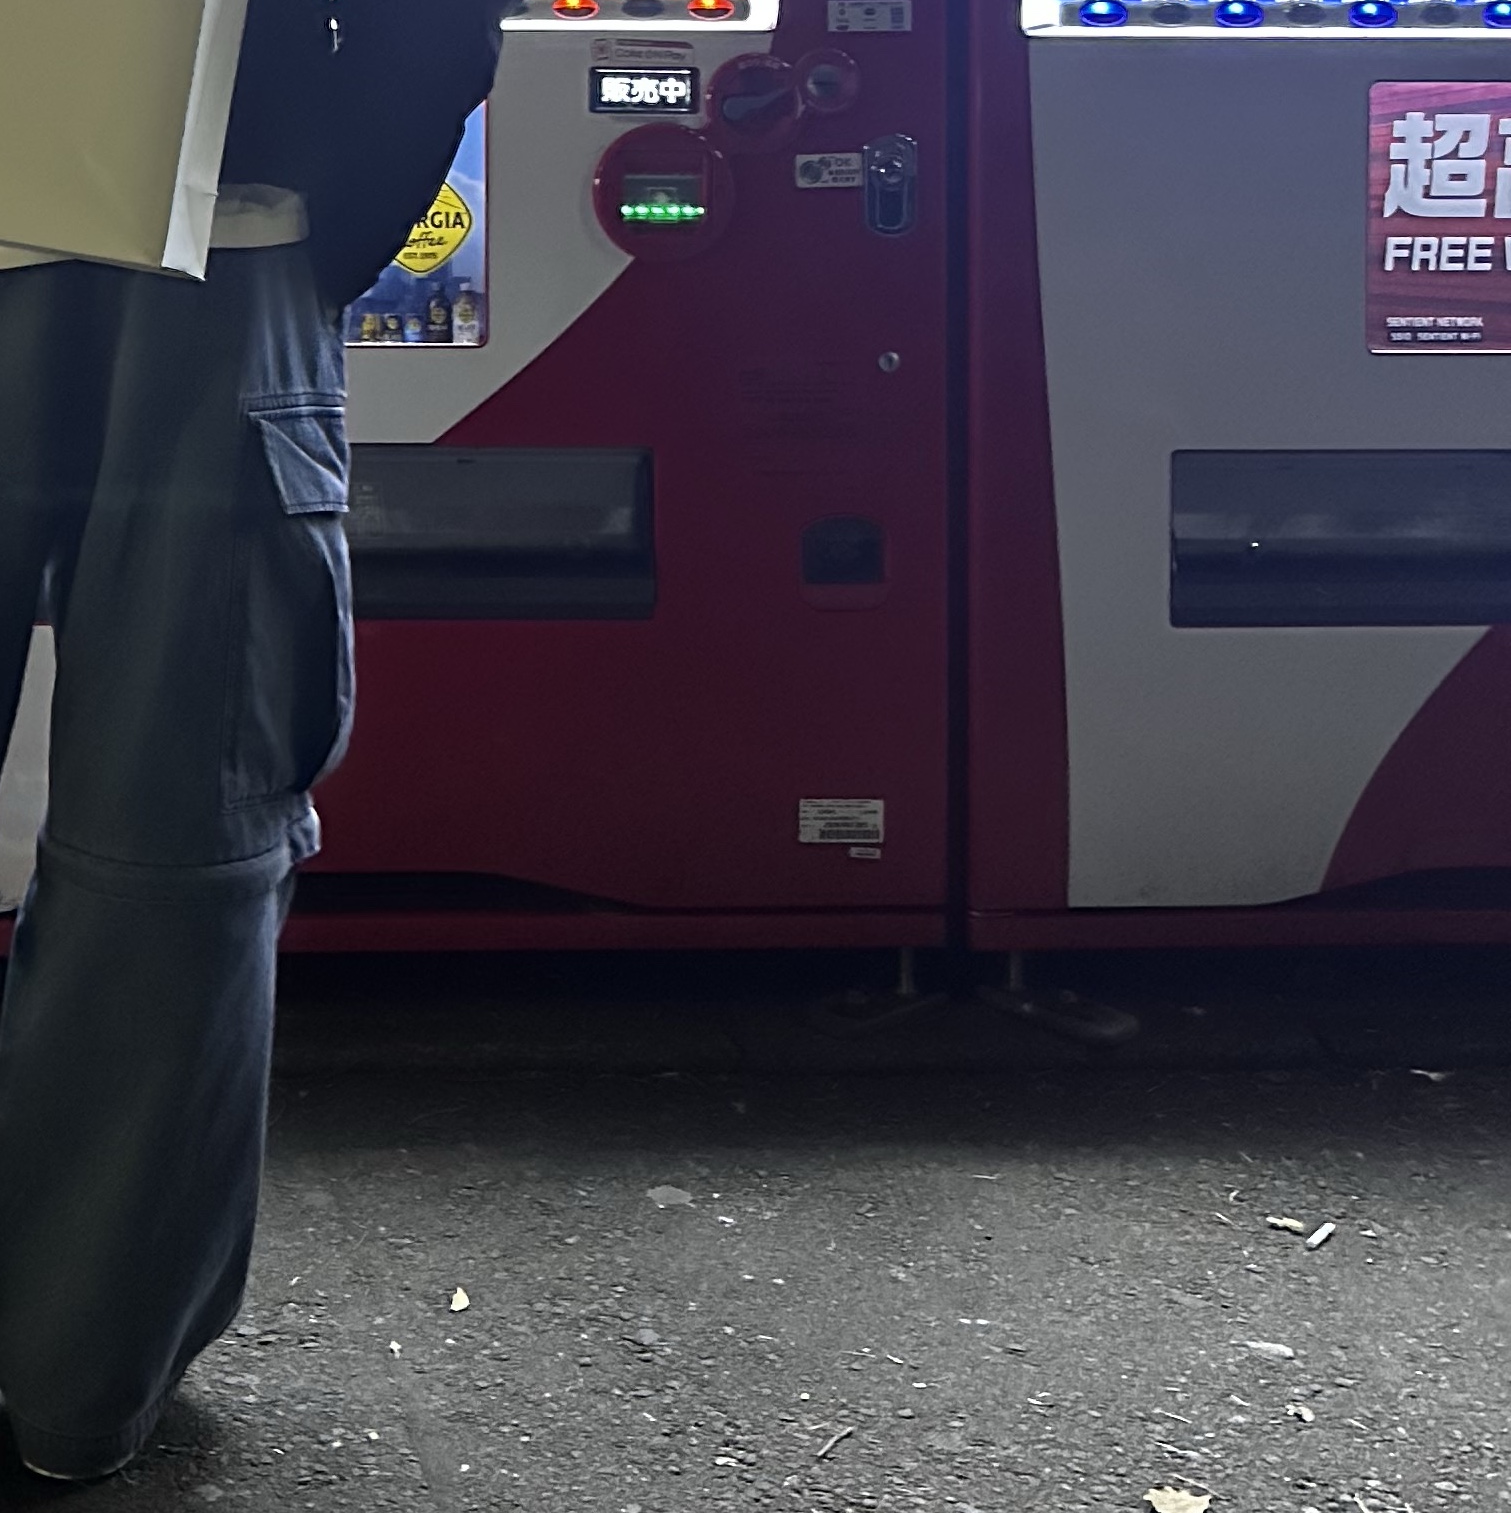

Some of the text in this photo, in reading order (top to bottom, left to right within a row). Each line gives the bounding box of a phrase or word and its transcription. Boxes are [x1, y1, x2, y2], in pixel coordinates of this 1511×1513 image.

[600, 76, 687, 104] 販売中
[1383, 235, 1496, 272] FREE
